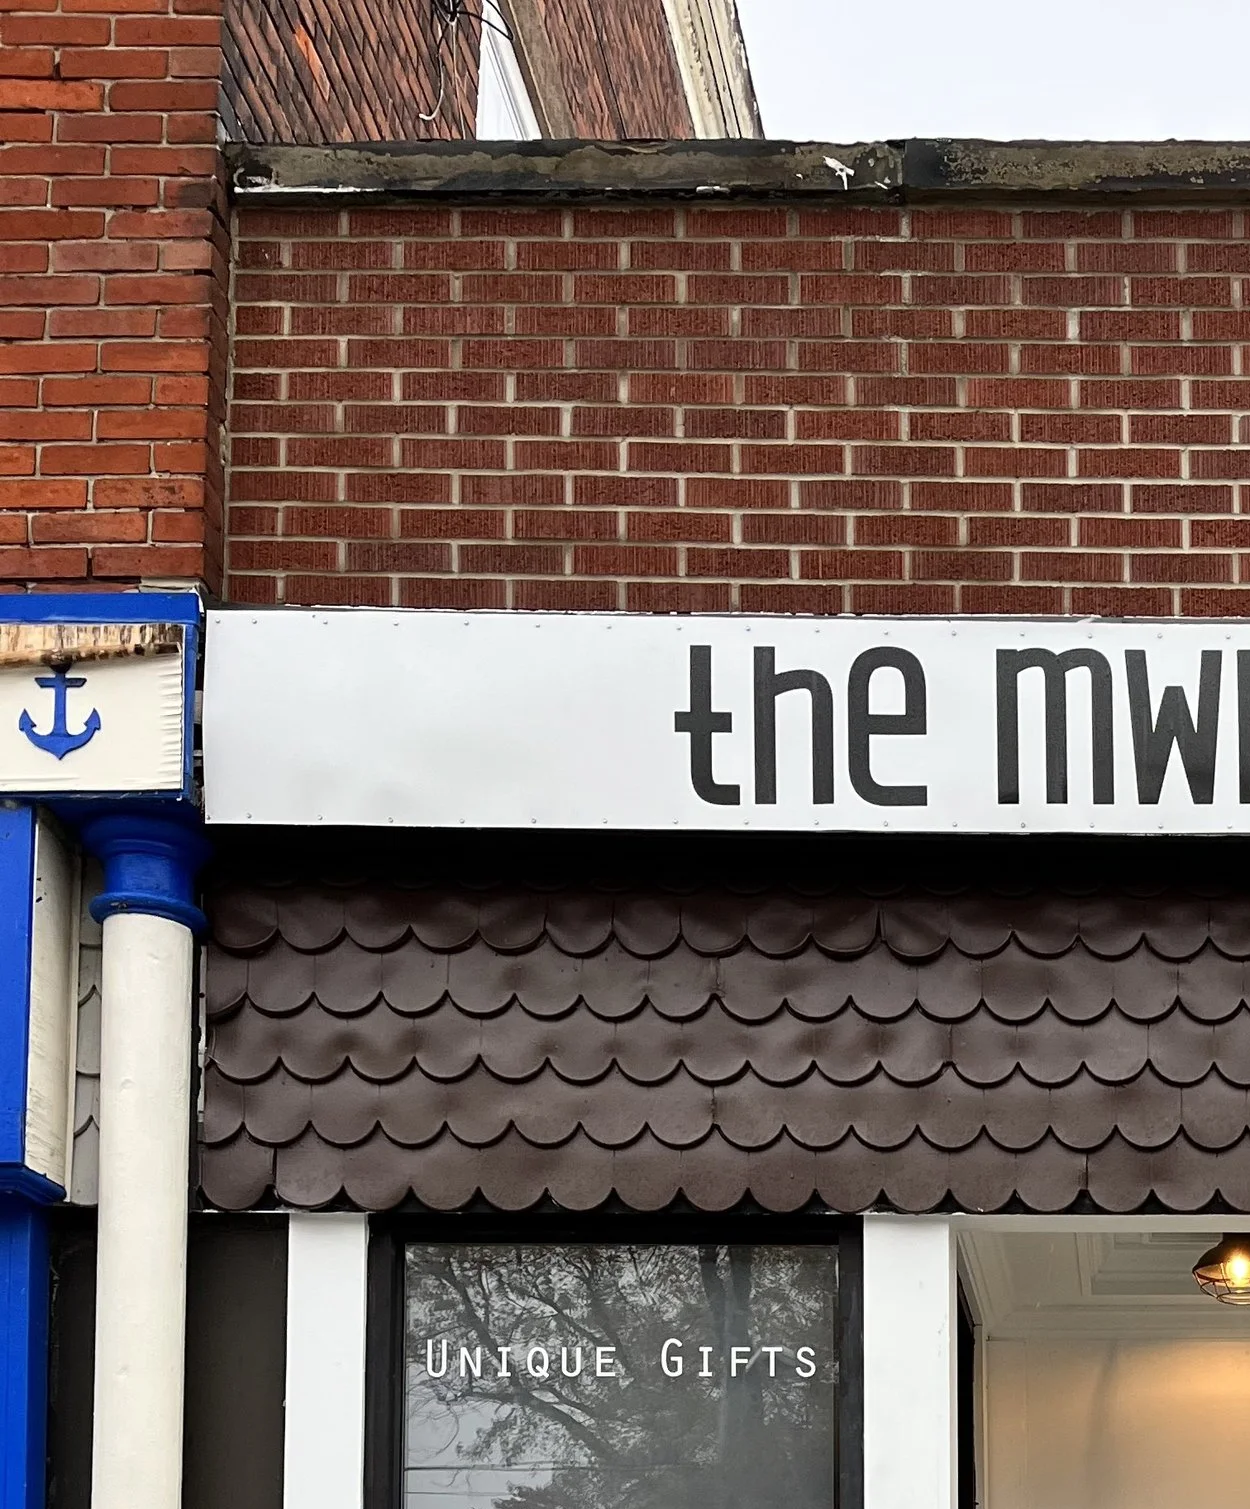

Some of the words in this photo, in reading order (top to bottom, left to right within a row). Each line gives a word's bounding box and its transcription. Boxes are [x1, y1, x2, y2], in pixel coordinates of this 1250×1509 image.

[674, 645, 928, 807] the
[425, 1338, 617, 1379] UNIQUE
[660, 1337, 817, 1379] GIFTS
